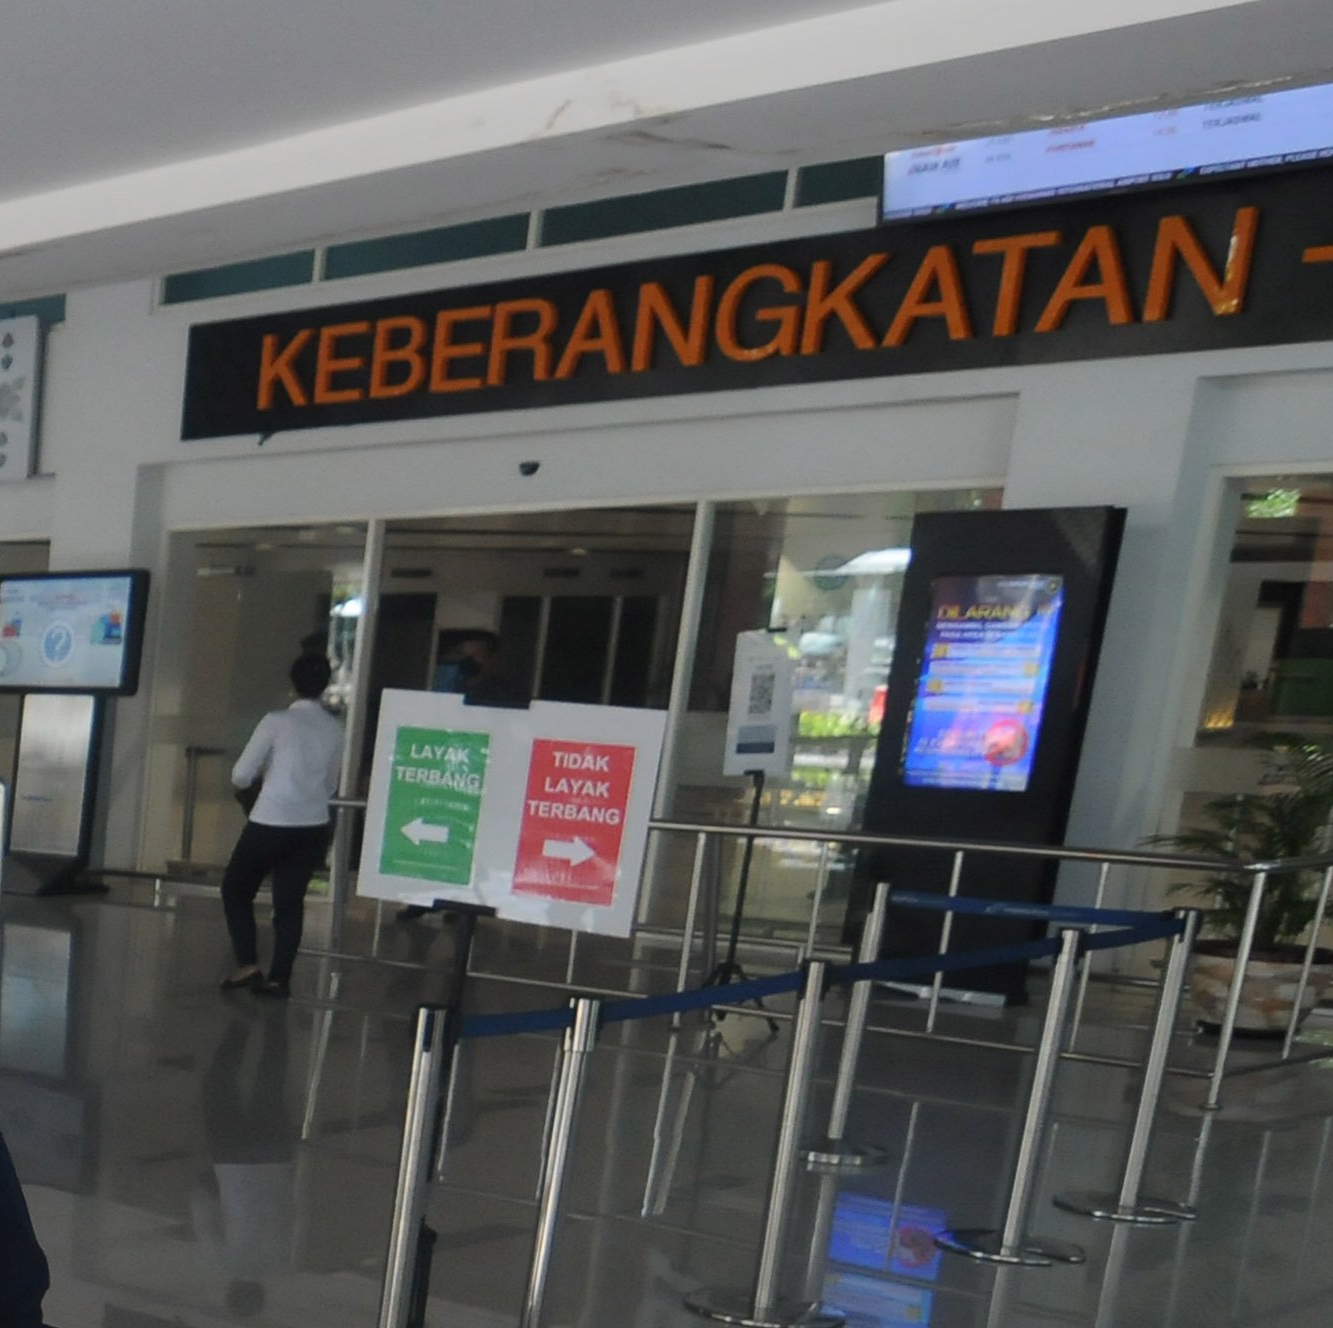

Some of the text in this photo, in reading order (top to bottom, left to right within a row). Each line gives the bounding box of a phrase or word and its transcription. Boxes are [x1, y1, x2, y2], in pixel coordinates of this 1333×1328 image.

[256, 205, 1259, 410] KEBERANGKATAN
[410, 743, 470, 764] LAYAK
[552, 751, 609, 772] TIDAK
[395, 766, 480, 788] TERBANG
[544, 777, 610, 798] LAYAK
[528, 800, 620, 825] TERBANG
